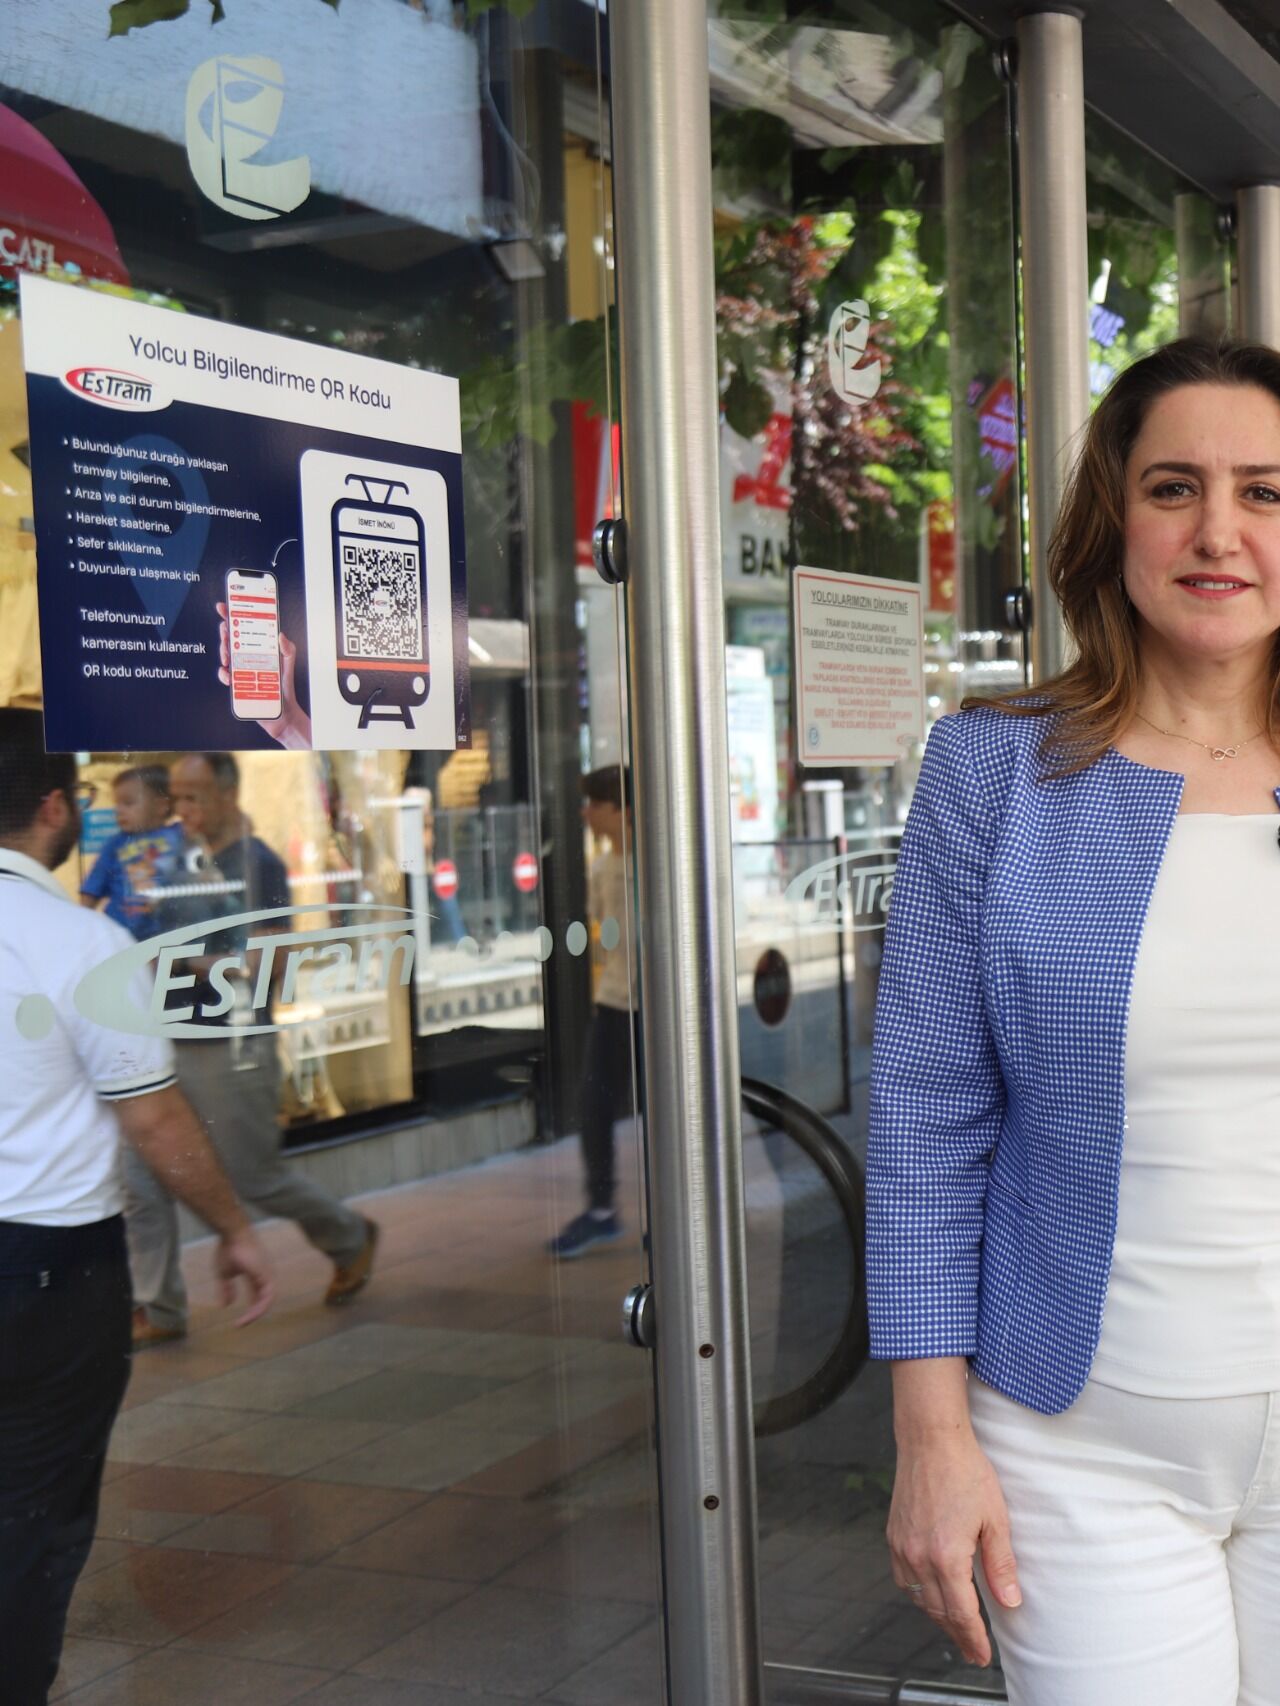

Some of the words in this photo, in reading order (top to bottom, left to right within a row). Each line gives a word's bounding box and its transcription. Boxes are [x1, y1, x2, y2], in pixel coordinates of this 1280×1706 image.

[129, 334, 188, 366] Yolcu
[193, 349, 315, 394] Bilgilendirme
[320, 378, 345, 400] QR
[349, 383, 391, 410] Kodu
[81, 371, 152, 403] EsTram
[72, 438, 149, 459] Bulunduğunuz
[150, 450, 185, 466] durağa
[187, 457, 229, 472] yaklaşan
[73, 462, 117, 480] tramvay
[120, 469, 171, 487] bilgilerine,
[74, 487, 102, 501] Arıza
[104, 492, 117, 503] ve
[119, 494, 137, 505] acil
[139, 496, 172, 510] durum
[174, 501, 262, 523] bilgilendirmelerine,
[76, 511, 118, 527] Hareket
[120, 515, 173, 534] saatlerine,
[77, 536, 105, 549] Sefer
[108, 540, 164, 557] sıklıklarına,
[78, 561, 136, 577] Duyurulara
[139, 566, 181, 581] ulaşmak
[183, 569, 200, 583] için
[80, 608, 166, 625] Telefonunuzun
[82, 637, 147, 651] kamerasını
[149, 640, 206, 654] kullanarak
[83, 664, 100, 678] QR
[103, 664, 132, 678] kodu
[134, 665, 190, 680] okutunuz.
[814, 864, 897, 922] EsTra
[151, 918, 417, 1024] EsTram
